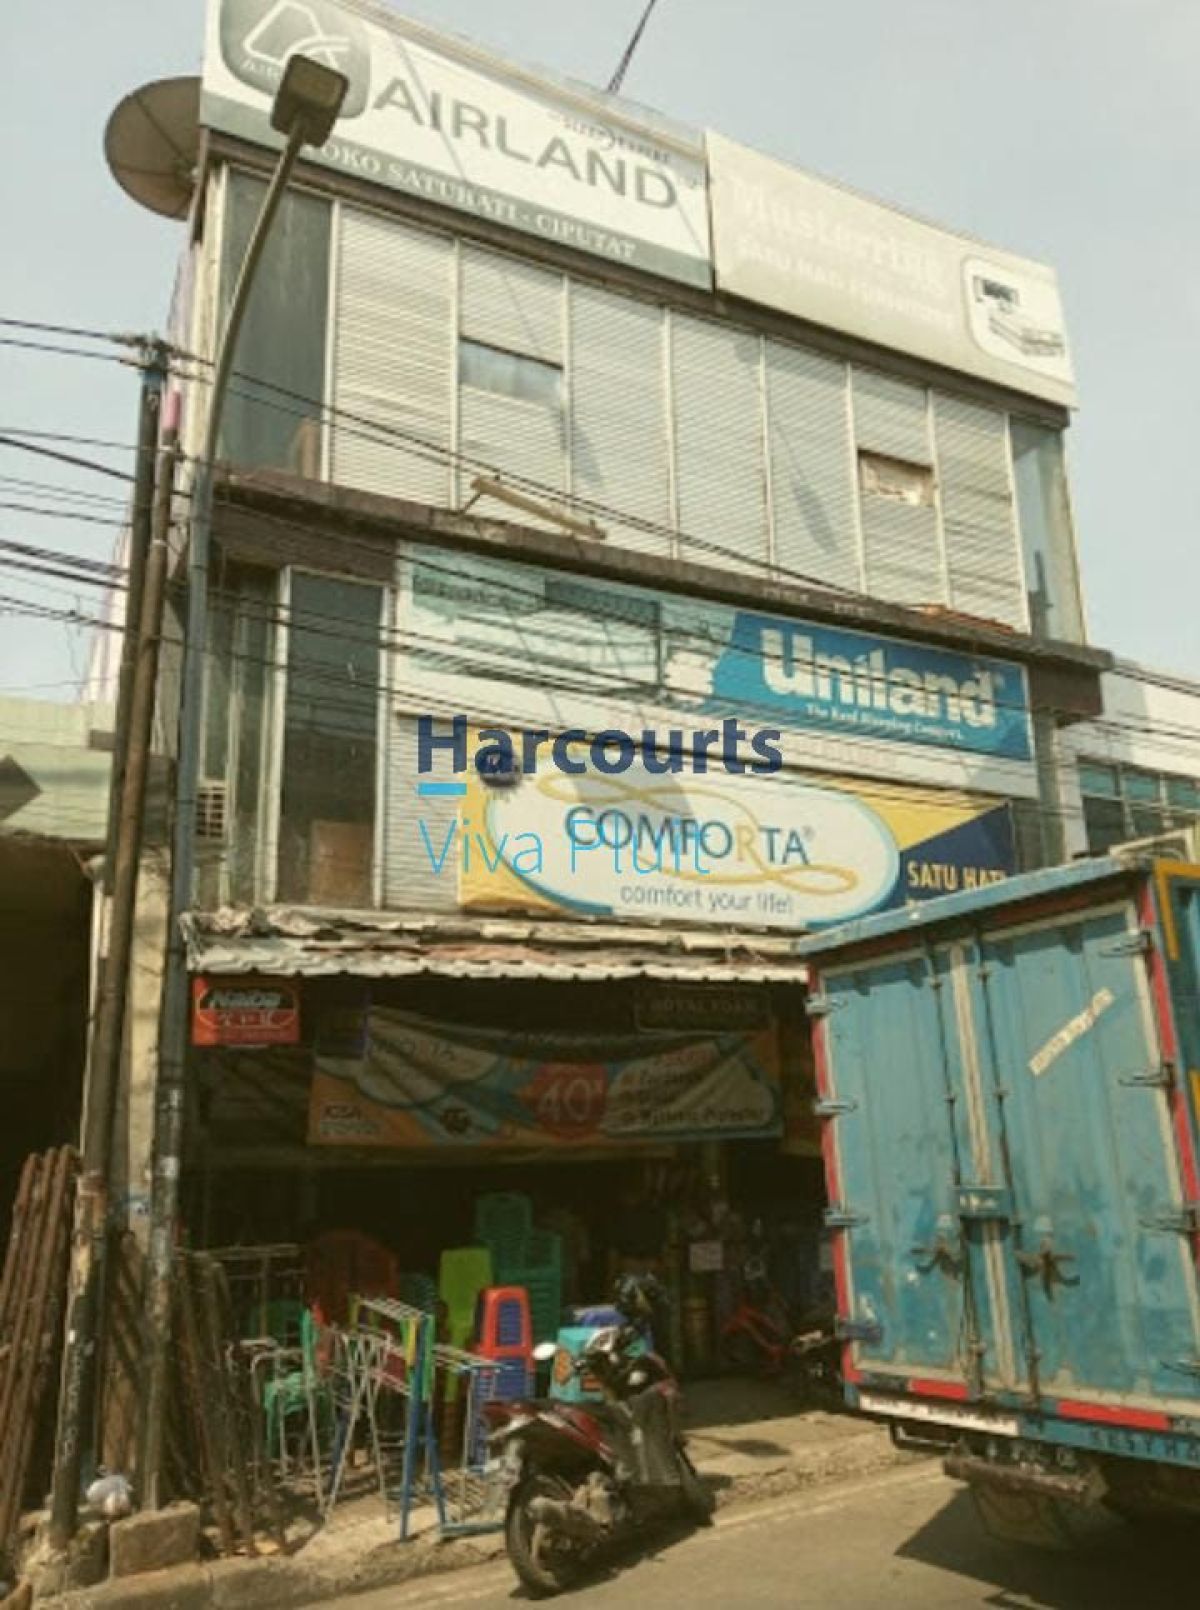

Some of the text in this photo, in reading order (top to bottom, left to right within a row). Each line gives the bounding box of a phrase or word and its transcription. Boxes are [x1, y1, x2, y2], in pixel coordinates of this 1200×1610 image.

[374, 78, 678, 210] AIRLAND
[537, 209, 637, 260] CIPUTAT
[760, 628, 997, 729] Uniland
[565, 805, 811, 865] COMFORTA
[620, 885, 702, 909] comfort
[708, 891, 752, 912] your
[907, 860, 958, 891] SATU
